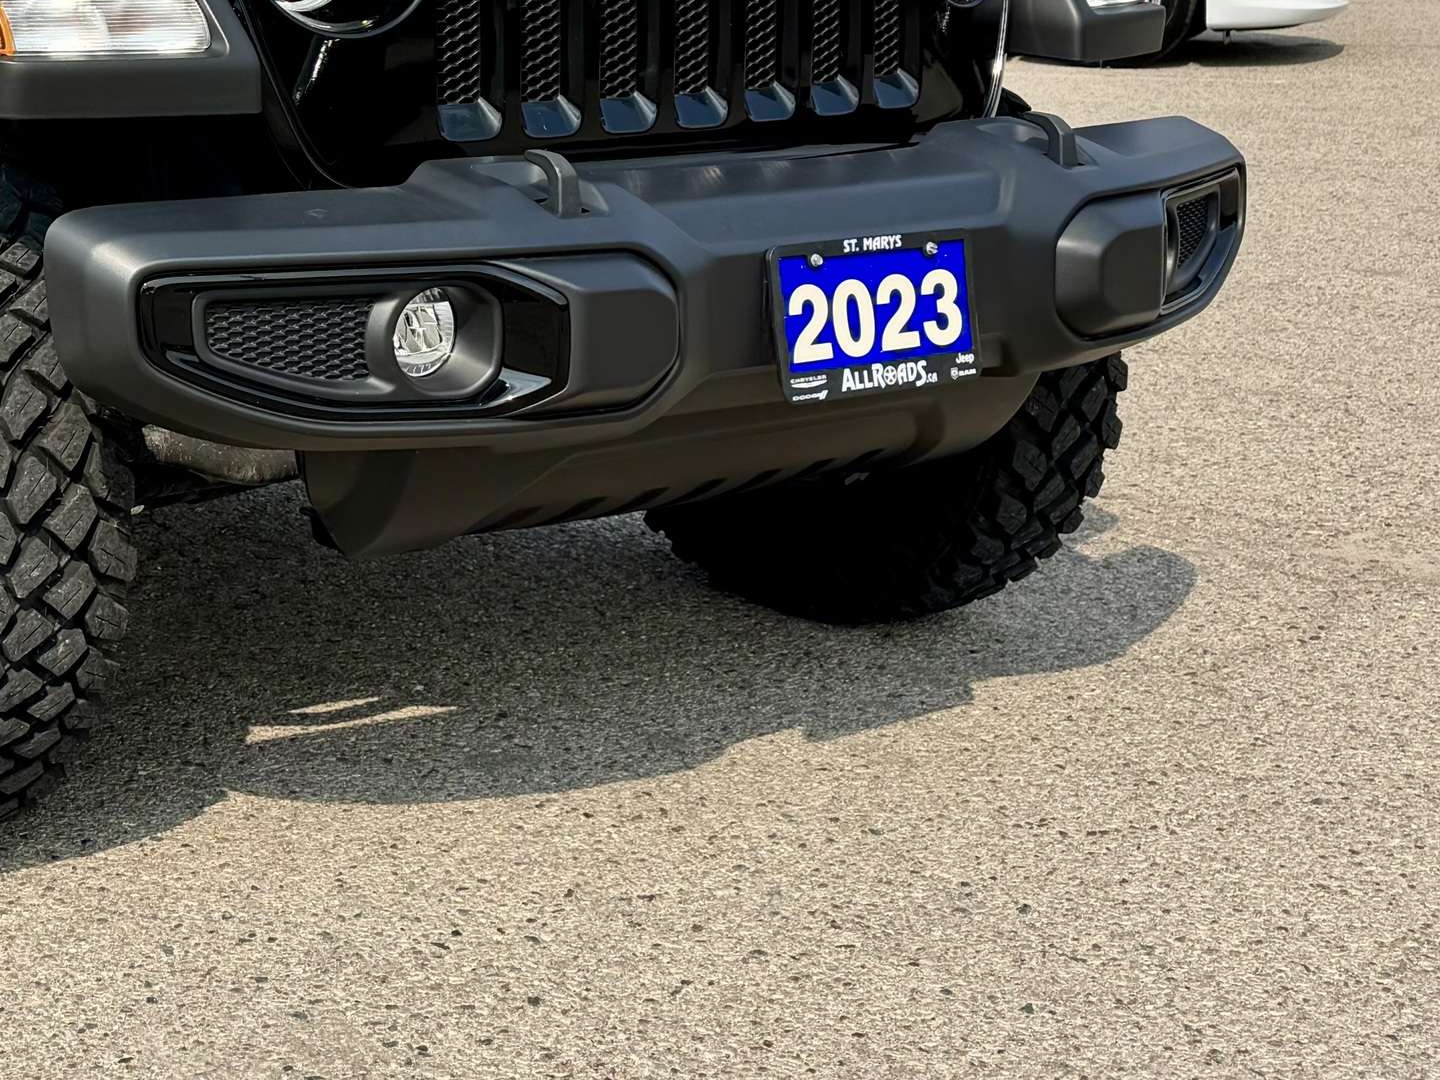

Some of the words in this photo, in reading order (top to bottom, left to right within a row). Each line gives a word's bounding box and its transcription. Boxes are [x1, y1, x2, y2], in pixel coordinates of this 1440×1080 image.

[843, 239, 860, 253] ST.
[863, 234, 902, 251] MARYS
[788, 268, 963, 364] 2023
[955, 352, 975, 364] Jeep
